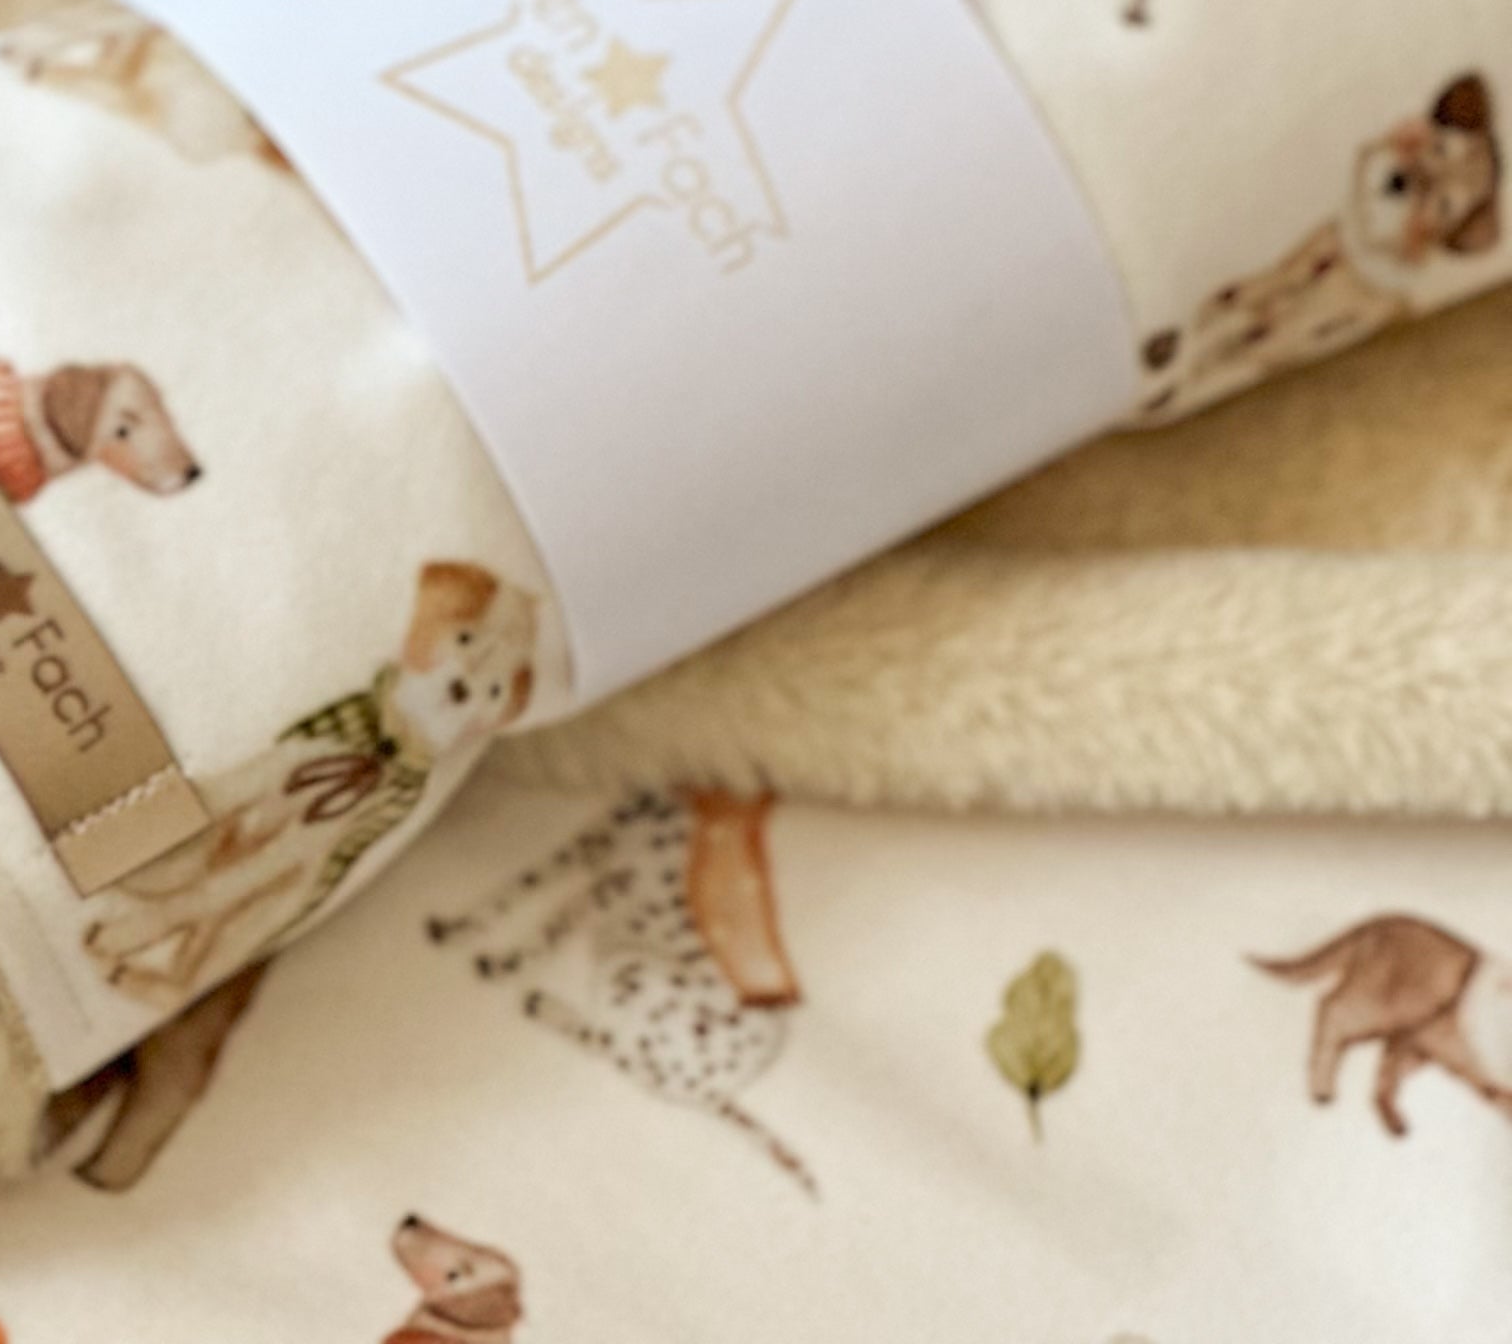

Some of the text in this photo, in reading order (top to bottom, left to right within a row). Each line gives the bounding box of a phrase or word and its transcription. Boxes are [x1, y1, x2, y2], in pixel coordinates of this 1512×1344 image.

[507, 46, 621, 183] designs
[636, 115, 758, 275] Fach
[12, 618, 114, 753] Fach
